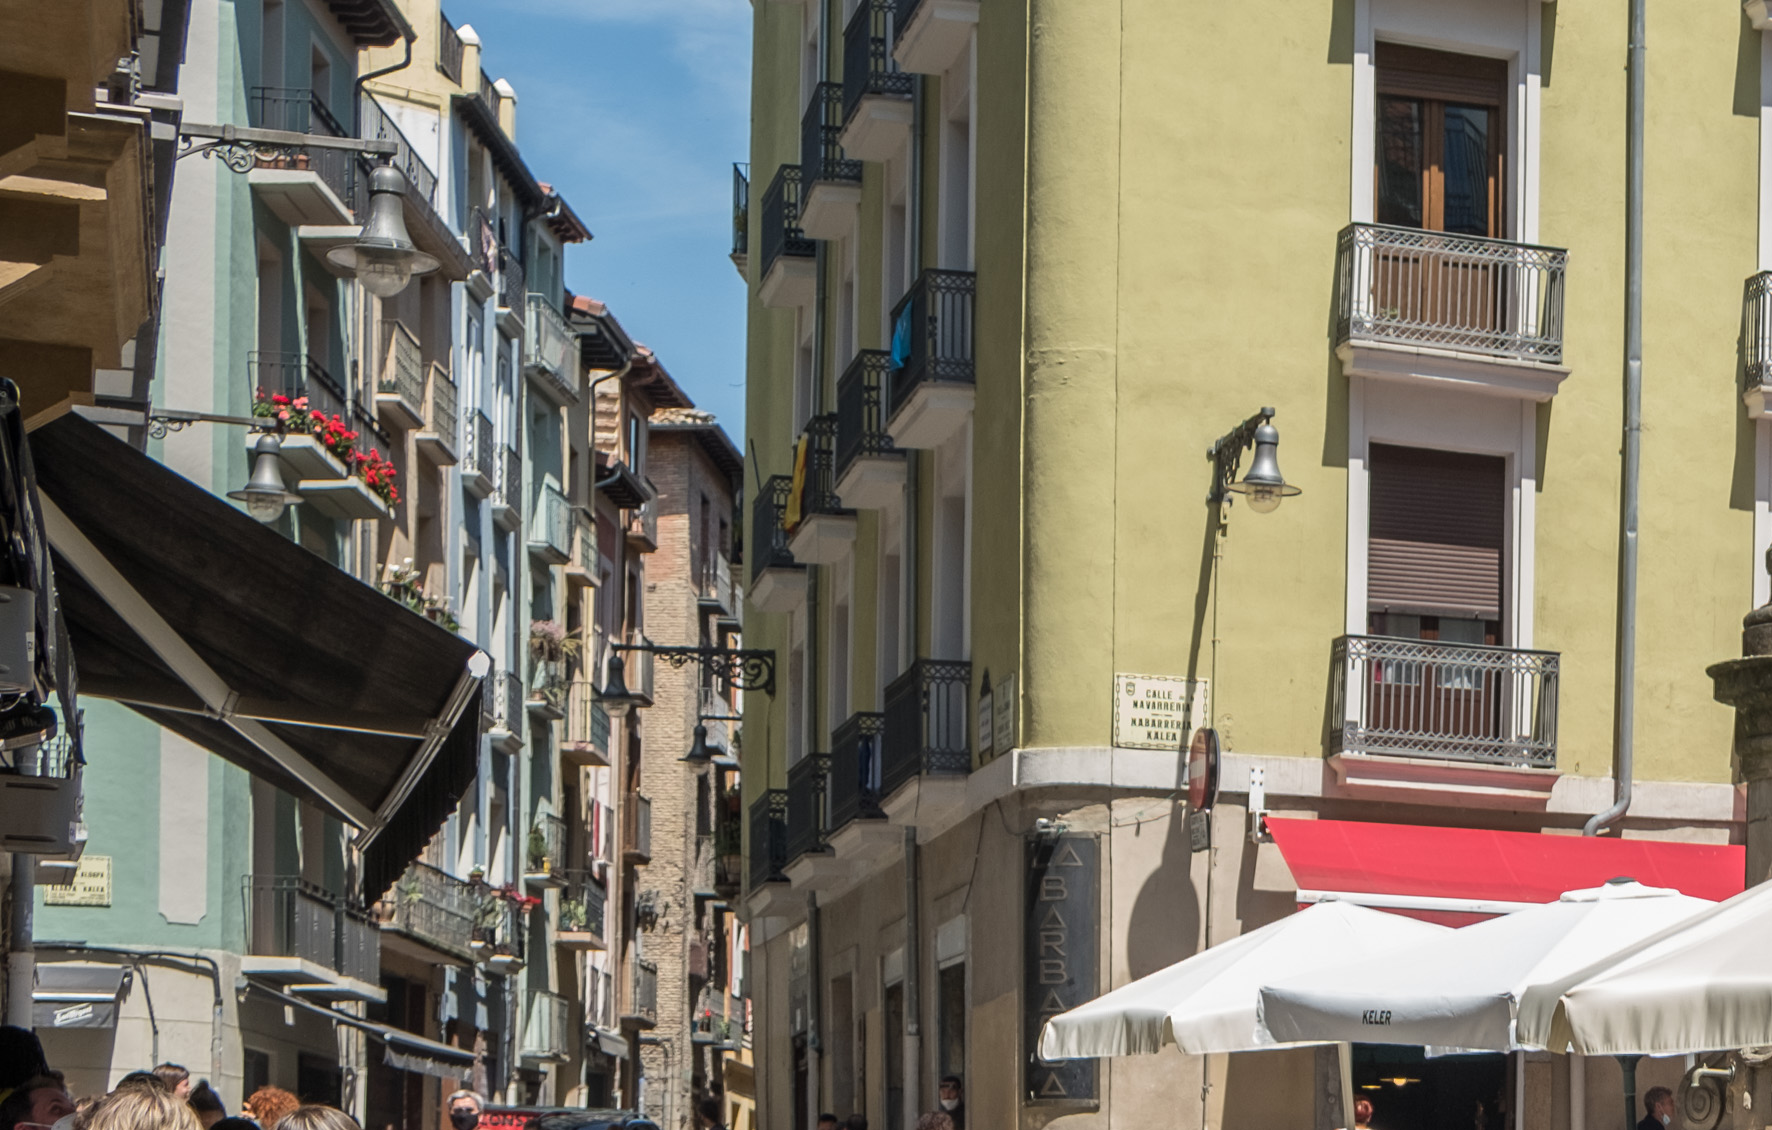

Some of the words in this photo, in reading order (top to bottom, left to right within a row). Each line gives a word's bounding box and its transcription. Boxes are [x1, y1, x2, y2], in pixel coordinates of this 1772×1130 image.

[1145, 689, 1172, 700] CALLE
[1131, 718, 1192, 730] NABARRERIA
[1147, 731, 1177, 741] KALEA
[1032, 841, 1084, 867] LA
[1038, 876, 1068, 1096] BARBAA
[1362, 1010, 1391, 1025] KELER
